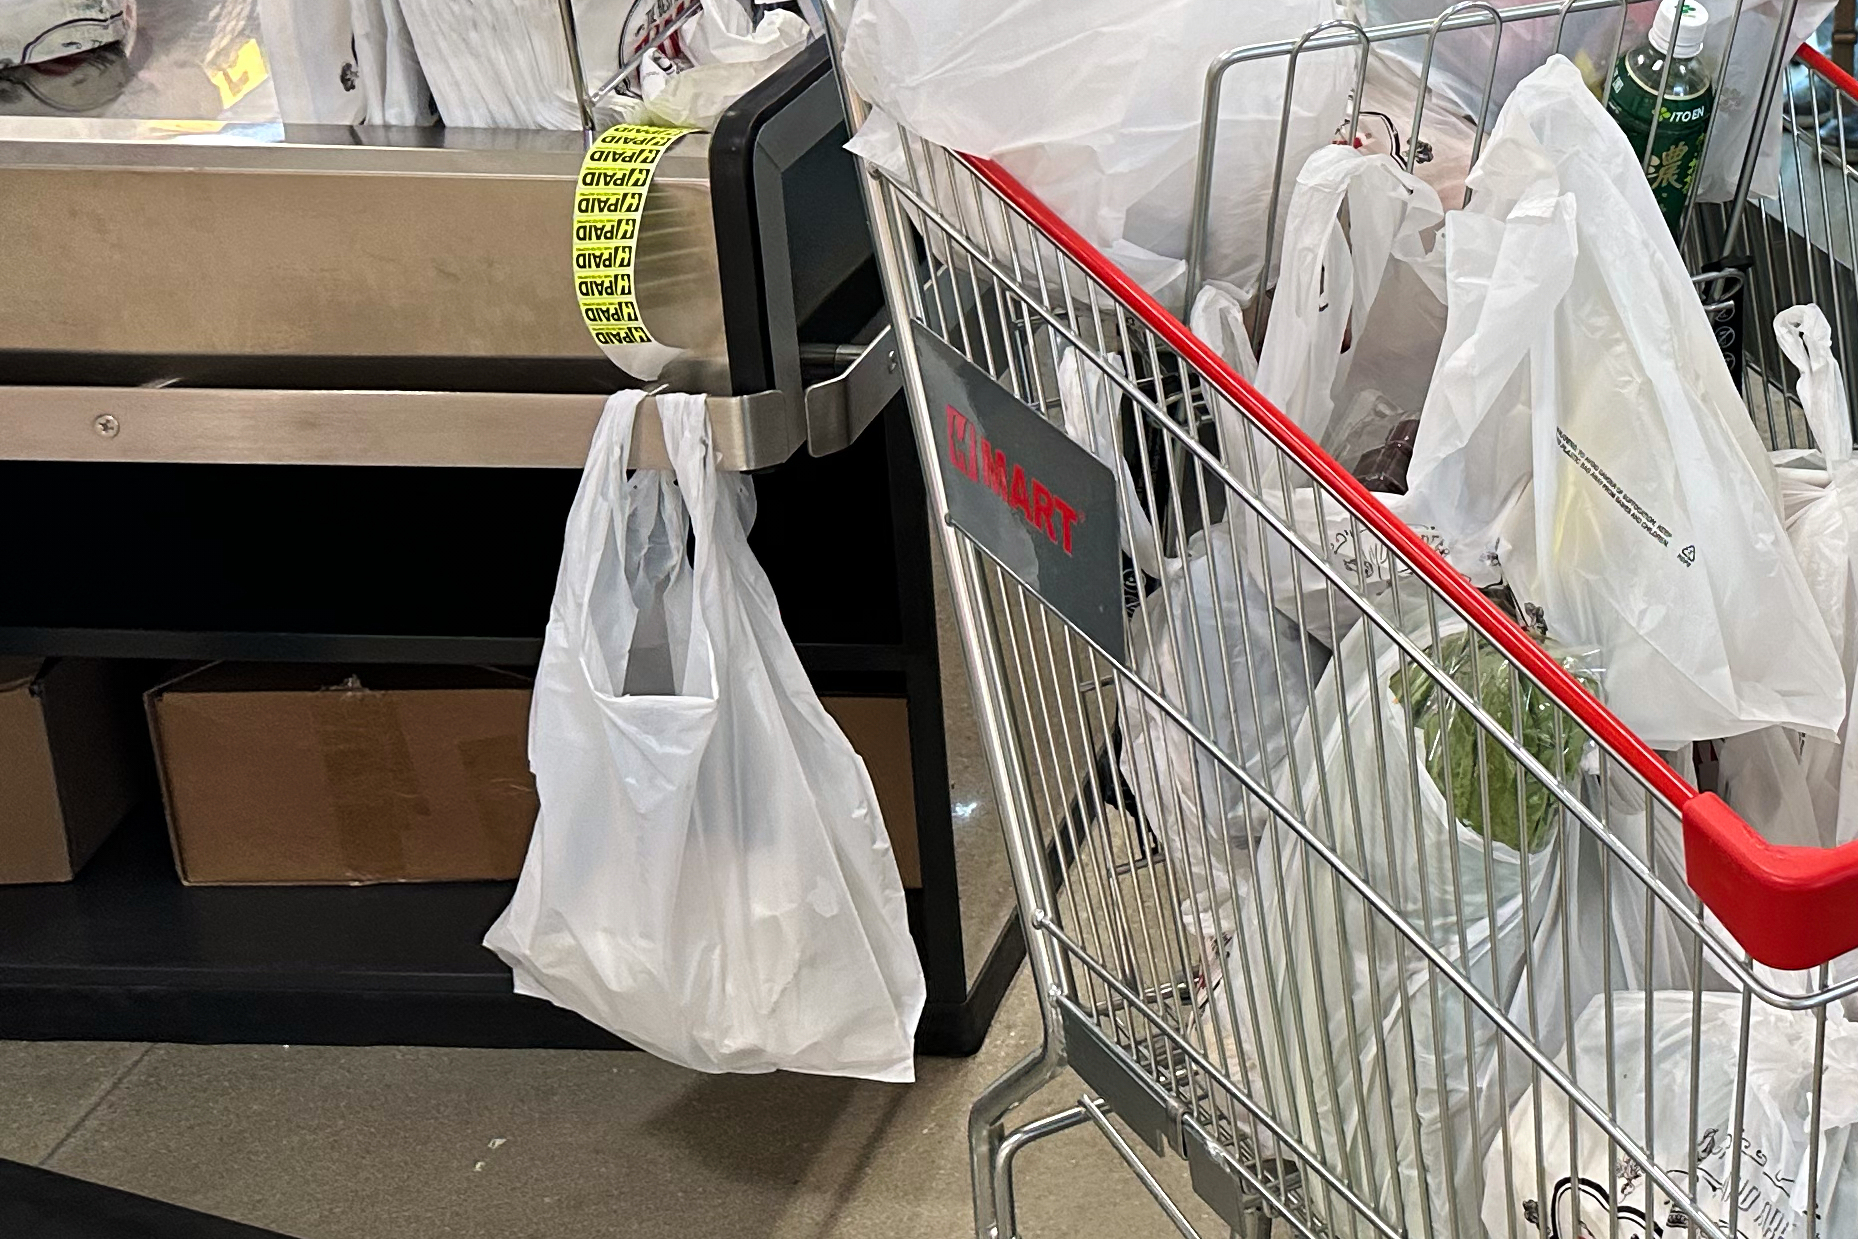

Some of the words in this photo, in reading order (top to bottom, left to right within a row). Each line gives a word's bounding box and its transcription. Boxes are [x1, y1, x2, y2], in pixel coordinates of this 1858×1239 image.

[590, 150, 636, 163] PAID
[582, 171, 627, 187] PAID
[578, 197, 620, 214] PAID
[576, 224, 615, 241] PAID
[576, 252, 613, 269] PAID
[578, 280, 614, 296] PAID
[584, 307, 621, 322] PAID
[595, 331, 637, 345] PAID
[981, 435, 1078, 558] MART
[1631, 512, 1642, 524] AND
